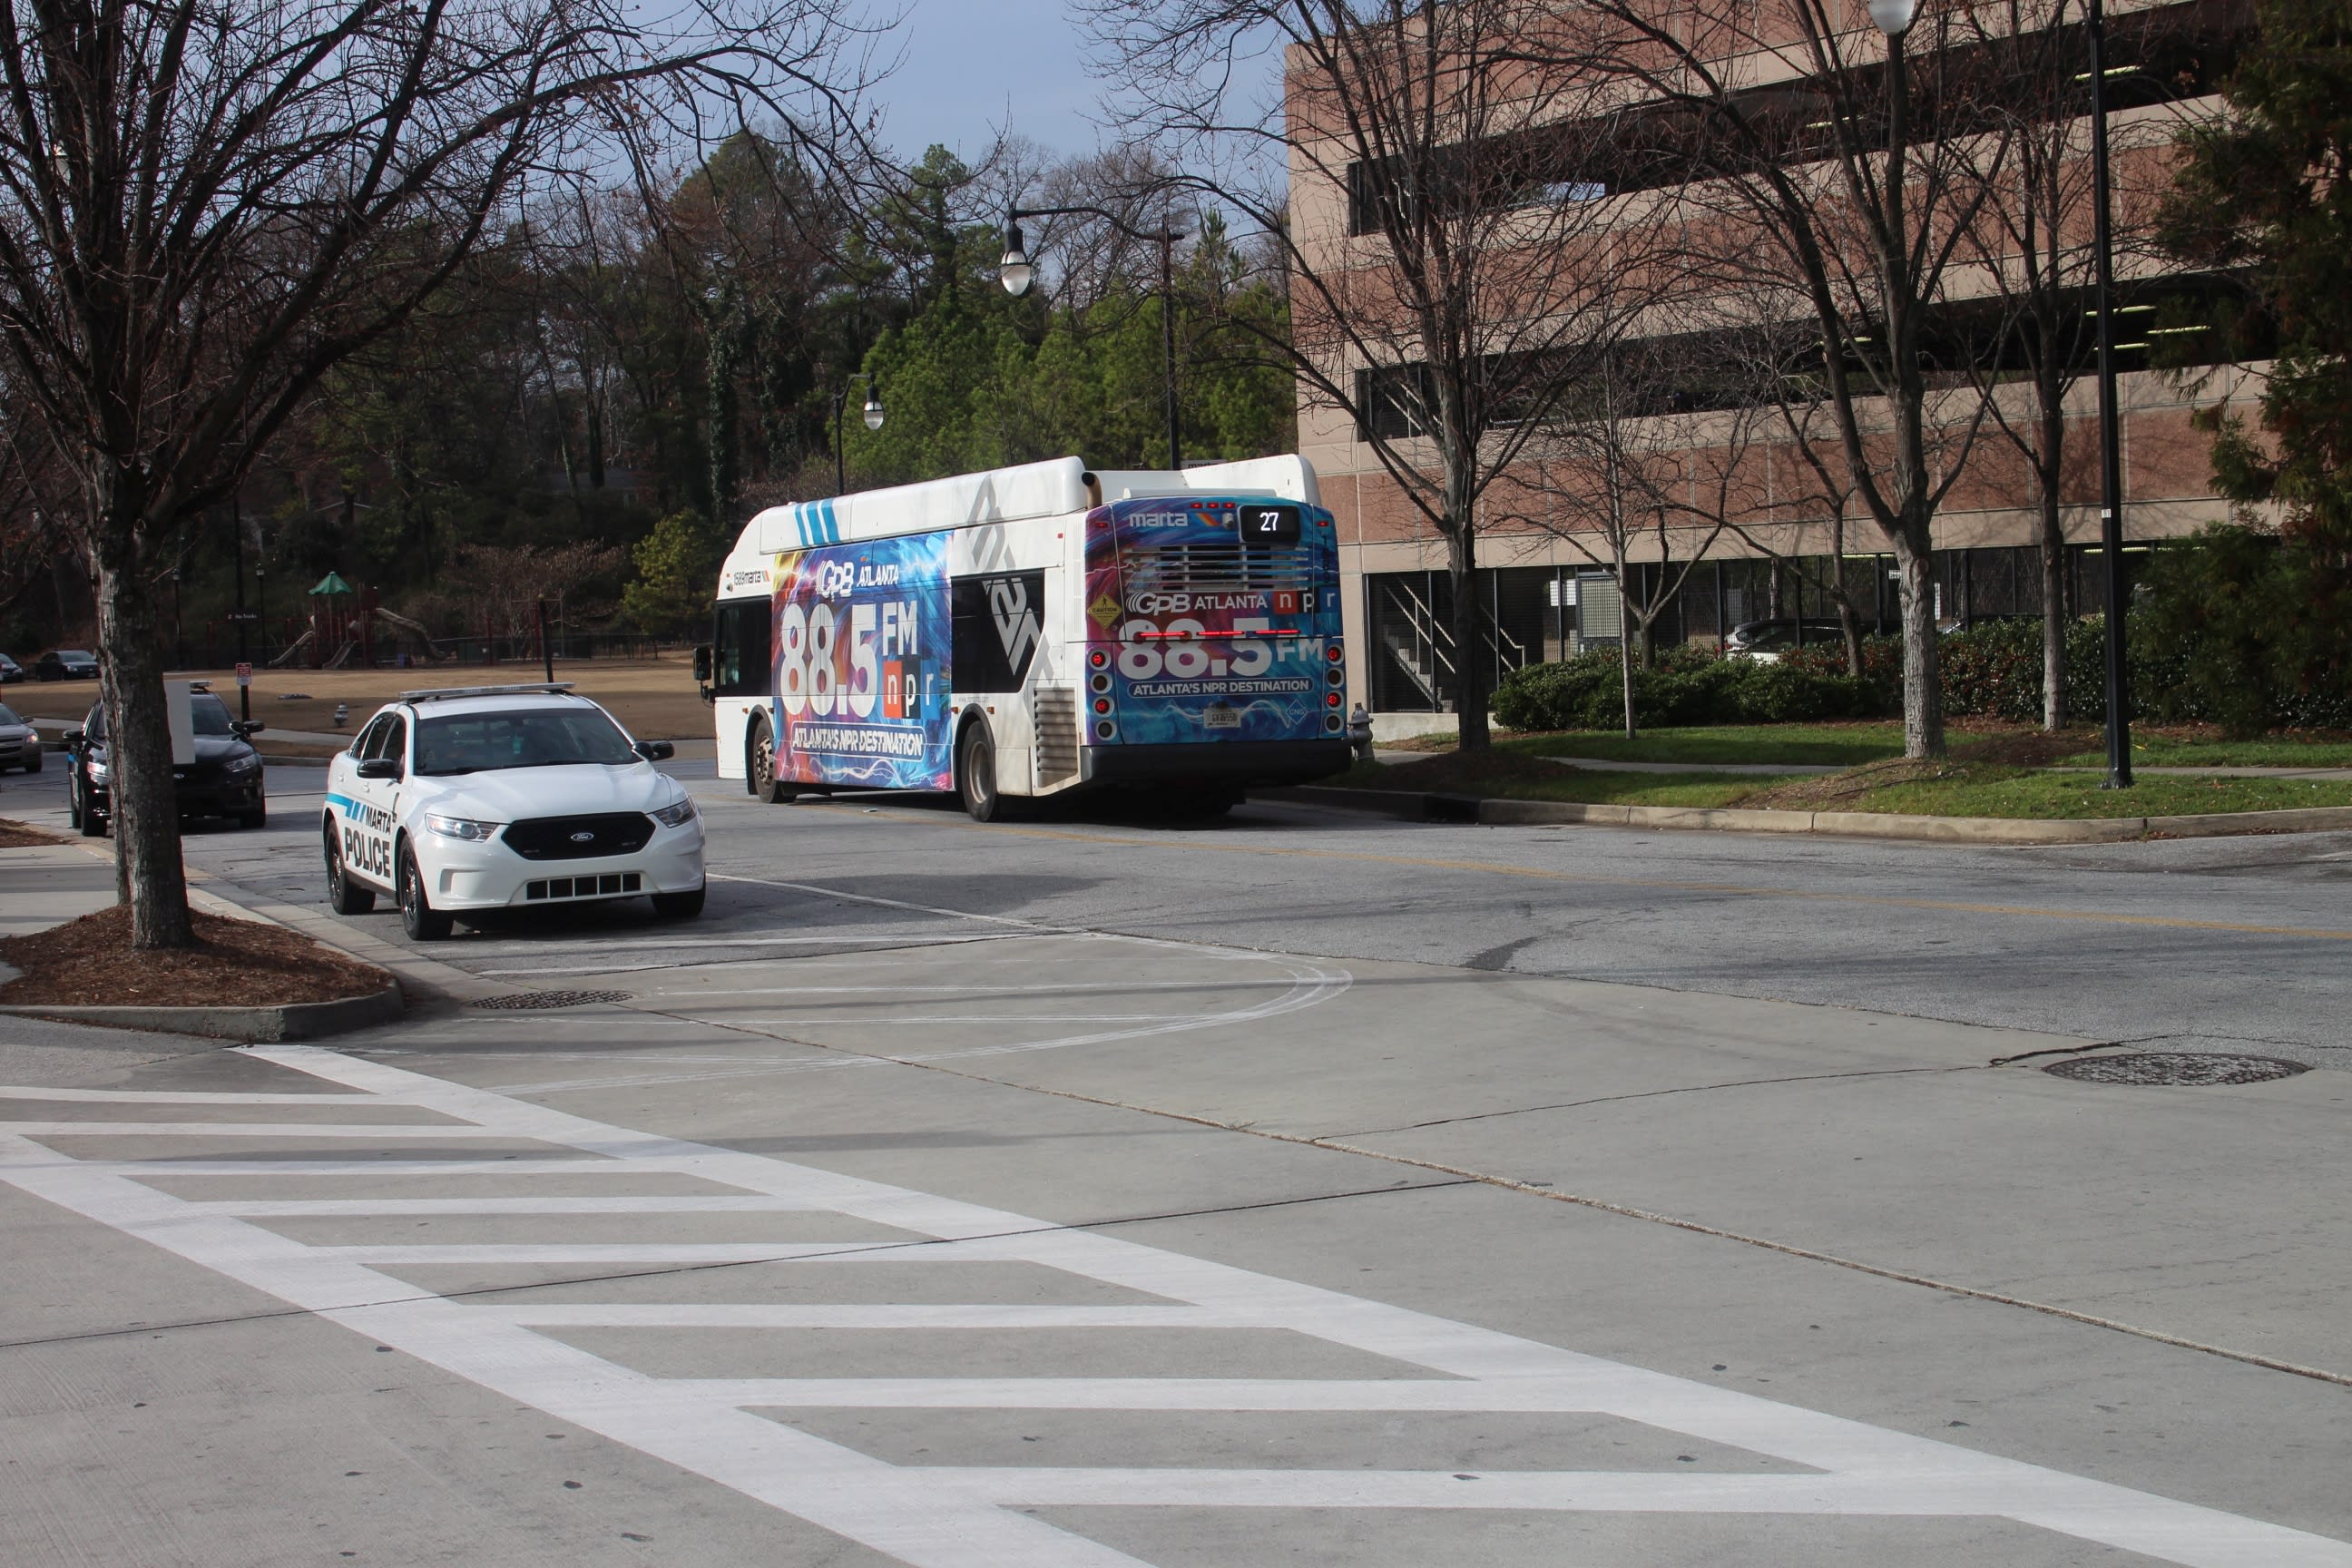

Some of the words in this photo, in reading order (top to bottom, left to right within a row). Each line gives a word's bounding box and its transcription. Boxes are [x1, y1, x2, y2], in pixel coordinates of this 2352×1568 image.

[1129, 511, 1189, 527] marta
[1259, 512, 1279, 532] 27
[816, 559, 855, 603] GPB
[856, 564, 899, 588] ATLANTA
[1126, 592, 1191, 616] GPB
[1193, 594, 1269, 611] ATLANTA
[780, 603, 878, 719] 88.5
[882, 600, 918, 656] FM
[1117, 617, 1273, 681] 88.5
[1277, 632, 1323, 662] FM
[1132, 683, 1200, 697] ATLANTA'S
[1202, 682, 1228, 694] NPR
[1230, 680, 1309, 693] DESTINATION
[1289, 708, 1305, 716] CNG
[792, 727, 840, 750] ATLANTA'S
[839, 729, 858, 751] NPR
[858, 730, 924, 757] DESTINATION
[366, 806, 392, 835] MARTA
[344, 826, 391, 878] POLICE
